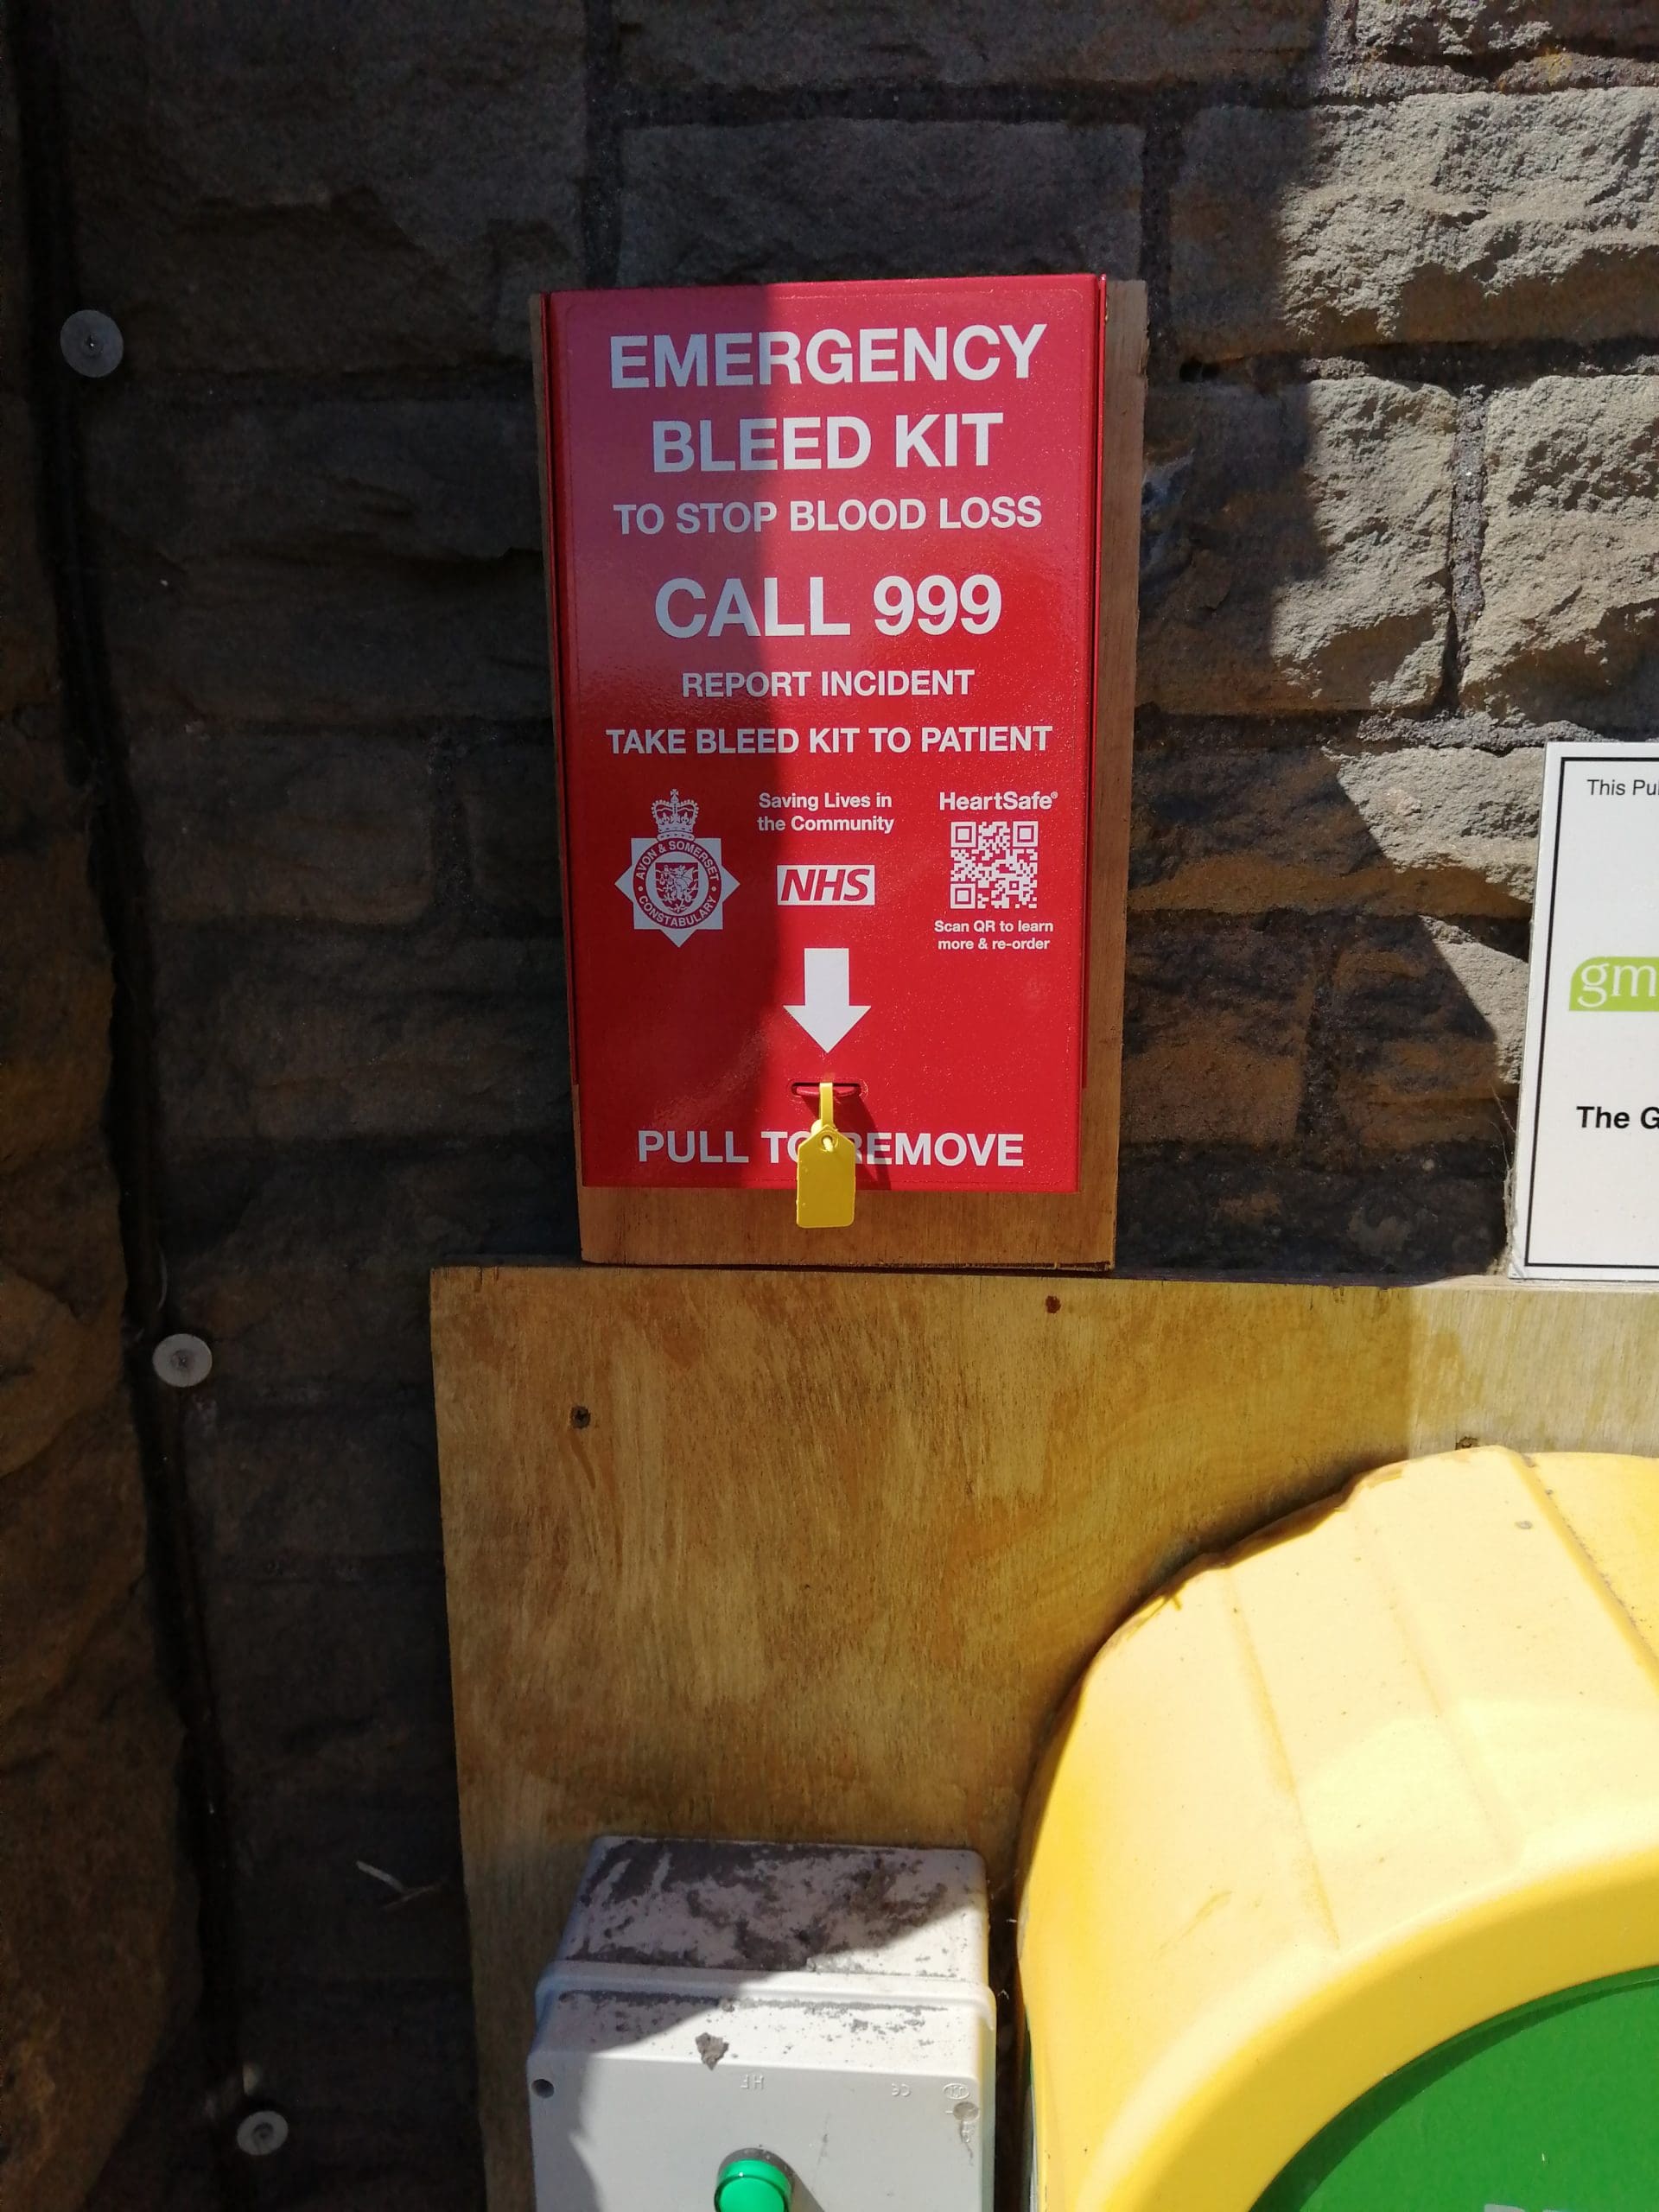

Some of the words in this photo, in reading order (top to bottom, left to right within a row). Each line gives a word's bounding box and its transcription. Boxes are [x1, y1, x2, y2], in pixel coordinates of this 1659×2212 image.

[610, 323, 1047, 389] EMERGENCY
[652, 416, 872, 473] BLEED
[895, 412, 1004, 468] KIT
[613, 503, 664, 535] TO
[677, 501, 778, 534] STOP
[790, 498, 926, 532] BLOOD
[939, 495, 1042, 529] LOSS
[655, 575, 851, 639] CALL
[873, 574, 1002, 636] 999
[682, 671, 812, 698] REPORT
[821, 669, 976, 696] INCIDENT
[606, 728, 687, 754] TAKE
[696, 728, 800, 754] BLEED
[809, 728, 861, 753] KIT
[868, 727, 912, 753] TO
[921, 725, 1053, 753] PATIENT
[759, 792, 819, 811] Saving
[824, 792, 871, 808] Lives
[876, 792, 893, 808] in
[1587, 779, 1625, 795] This
[1632, 779, 1659, 795] Pu
[757, 816, 786, 831] the
[791, 815, 894, 834] Community
[635, 849, 658, 880] AVON
[658, 843, 667, 854] &
[668, 840, 720, 881] SOMERSET
[780, 868, 870, 901] NHS
[639, 895, 717, 927] CONSTABULARY
[934, 920, 969, 932] Scan
[973, 919, 996, 933] QR
[999, 920, 1014, 932] to
[1018, 919, 1054, 932] learn
[938, 939, 975, 950] more
[977, 938, 988, 950] &
[992, 938, 1051, 950] re-order
[1576, 1106, 1630, 1128] The
[638, 1129, 749, 1163] PULL
